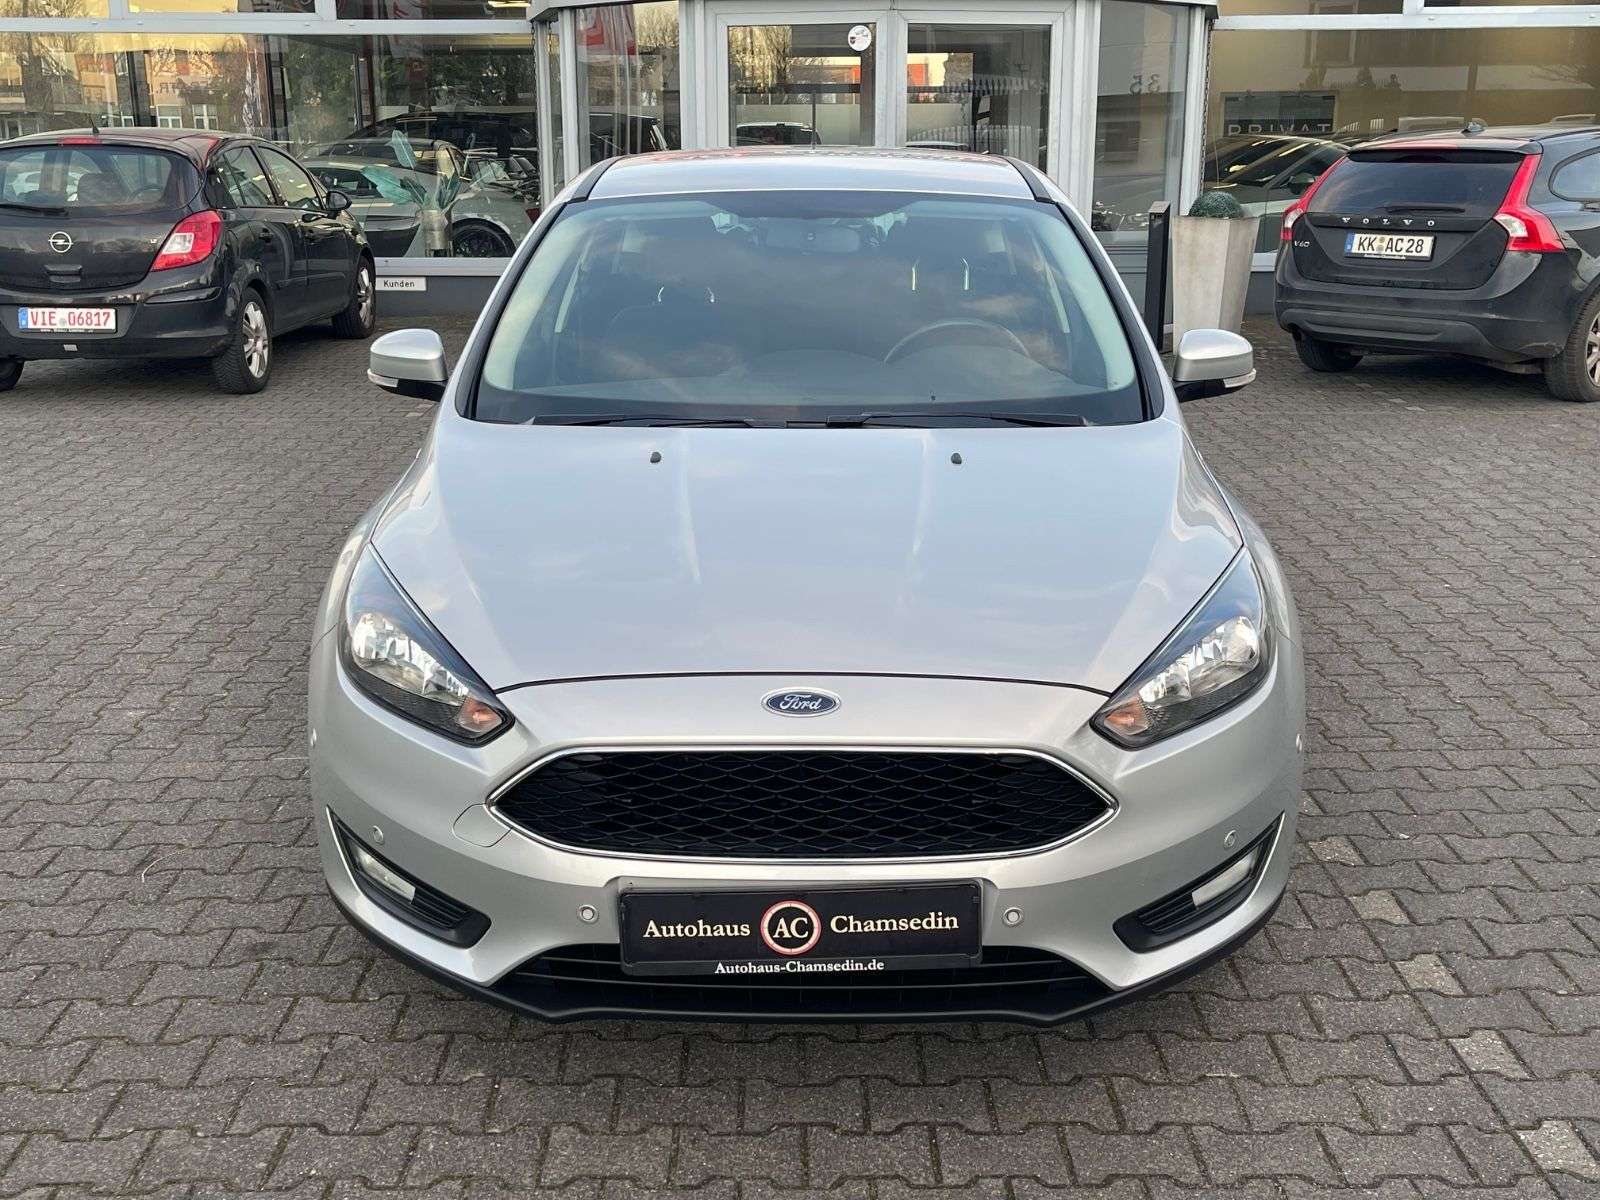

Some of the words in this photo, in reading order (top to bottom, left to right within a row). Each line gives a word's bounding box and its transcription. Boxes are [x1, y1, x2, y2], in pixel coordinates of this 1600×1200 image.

[1342, 216, 1435, 227] VOLVO
[1357, 236, 1378, 252] KK
[383, 280, 415, 288] Kunden
[31, 311, 57, 326] VIE
[67, 311, 111, 327] 06817
[780, 694, 822, 709] Ford
[643, 919, 751, 939] Autohaus
[773, 917, 809, 939] AC
[829, 911, 959, 934] Chamsedin
[714, 958, 885, 975] Autohaus-Chamsedin.de
